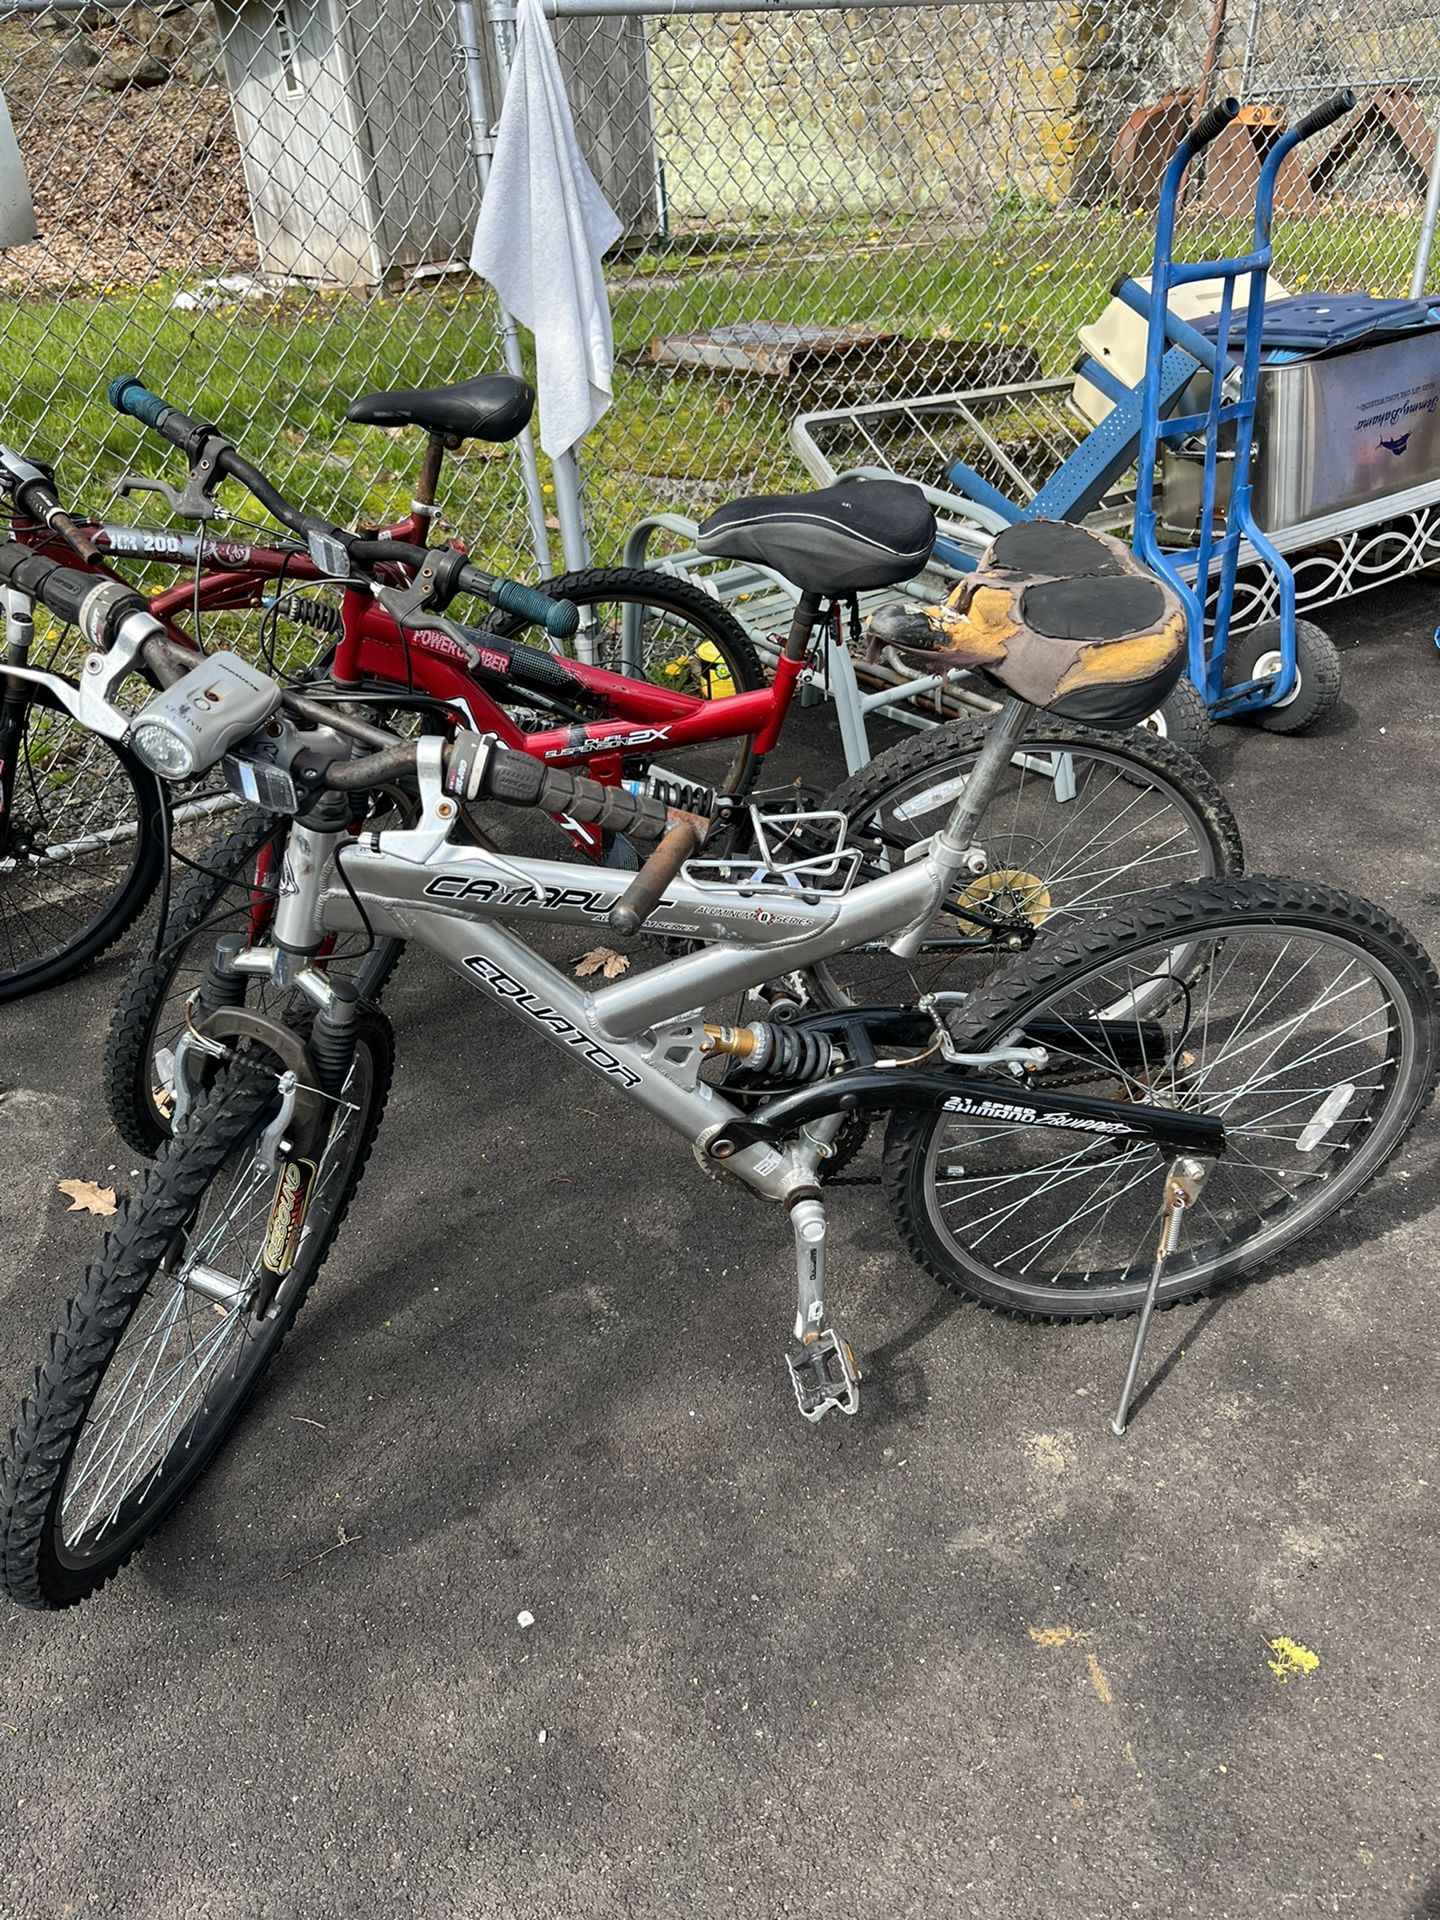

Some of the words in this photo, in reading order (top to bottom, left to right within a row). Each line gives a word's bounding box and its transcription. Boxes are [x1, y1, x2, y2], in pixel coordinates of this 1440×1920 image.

[143, 535, 179, 553] 200
[412, 629, 510, 674] POWERCMBER
[583, 733, 627, 746] DUAL
[422, 874, 678, 917] CATAPUT
[694, 905, 756, 921] ALUMINUM
[774, 915, 816, 927] SERIES
[462, 955, 644, 1089] EQUATOR
[942, 1102, 1036, 1124] SHIMANO
[949, 1096, 973, 1106] 21
[981, 1101, 1038, 1115] SPEED
[267, 1162, 301, 1267] REBOUND
